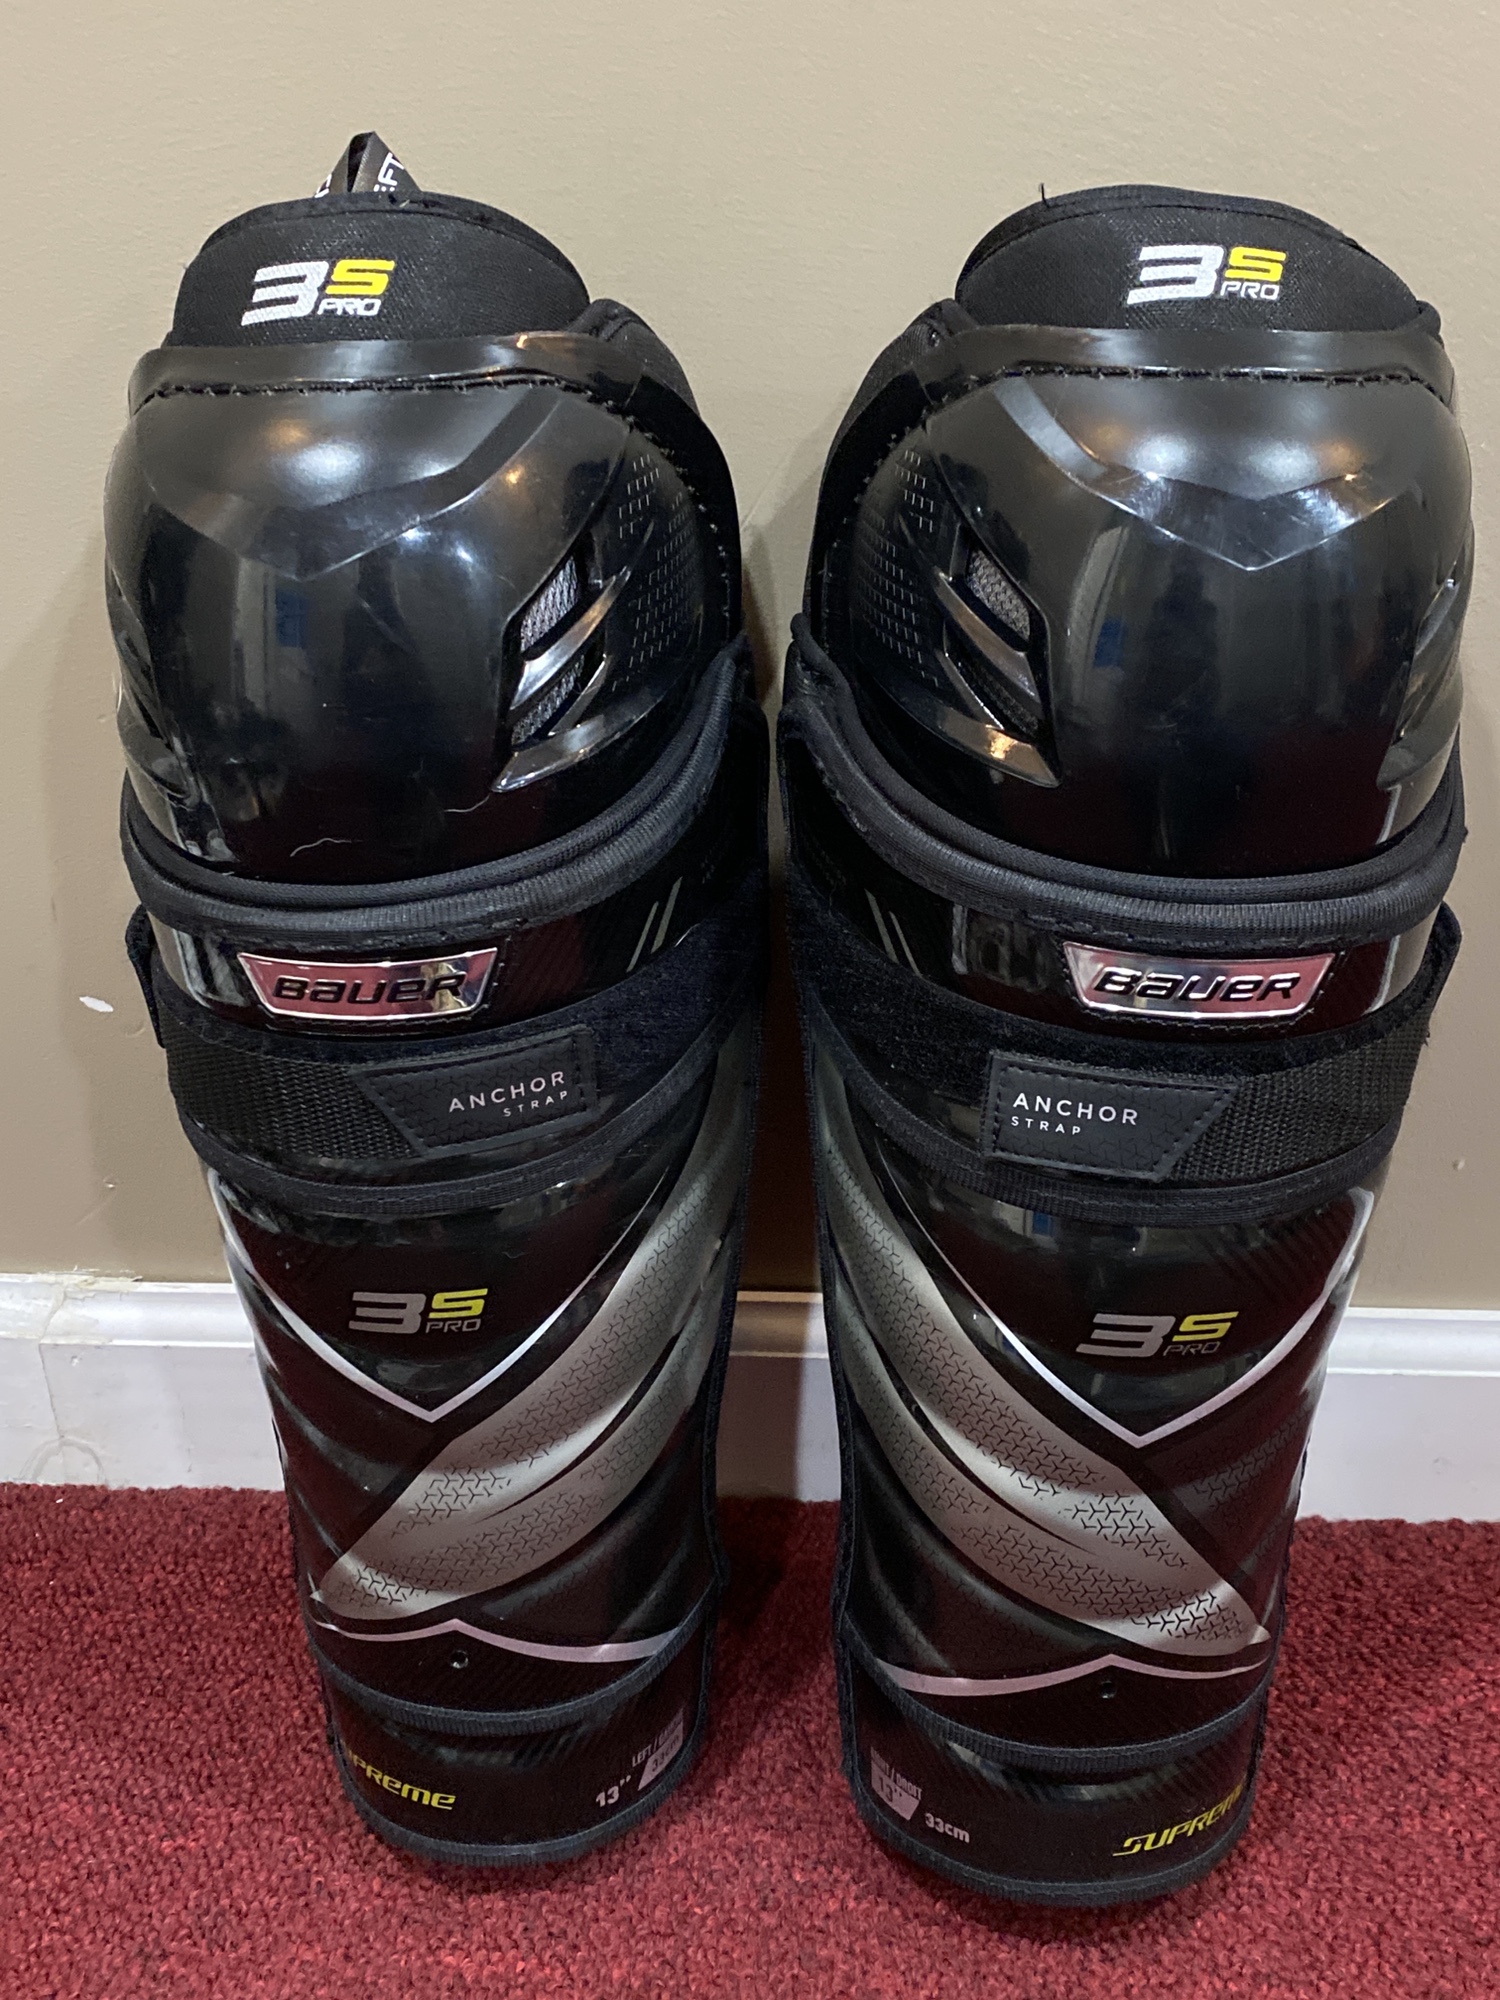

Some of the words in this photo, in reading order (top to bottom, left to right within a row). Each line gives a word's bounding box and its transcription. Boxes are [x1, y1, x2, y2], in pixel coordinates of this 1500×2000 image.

[1219, 281, 1281, 301] PRO
[316, 297, 382, 316] PRO
[272, 971, 468, 1005] BAUER
[1093, 966, 1301, 1002] BAUER
[449, 1070, 566, 1113] ANCHOR
[503, 1090, 569, 1118] STRAP
[1012, 1092, 1139, 1126] ANCHOR
[1011, 1116, 1082, 1136] STRAP
[425, 1318, 482, 1334] PRO
[1162, 1341, 1222, 1357] PRO
[925, 1812, 970, 1844] 33cm
